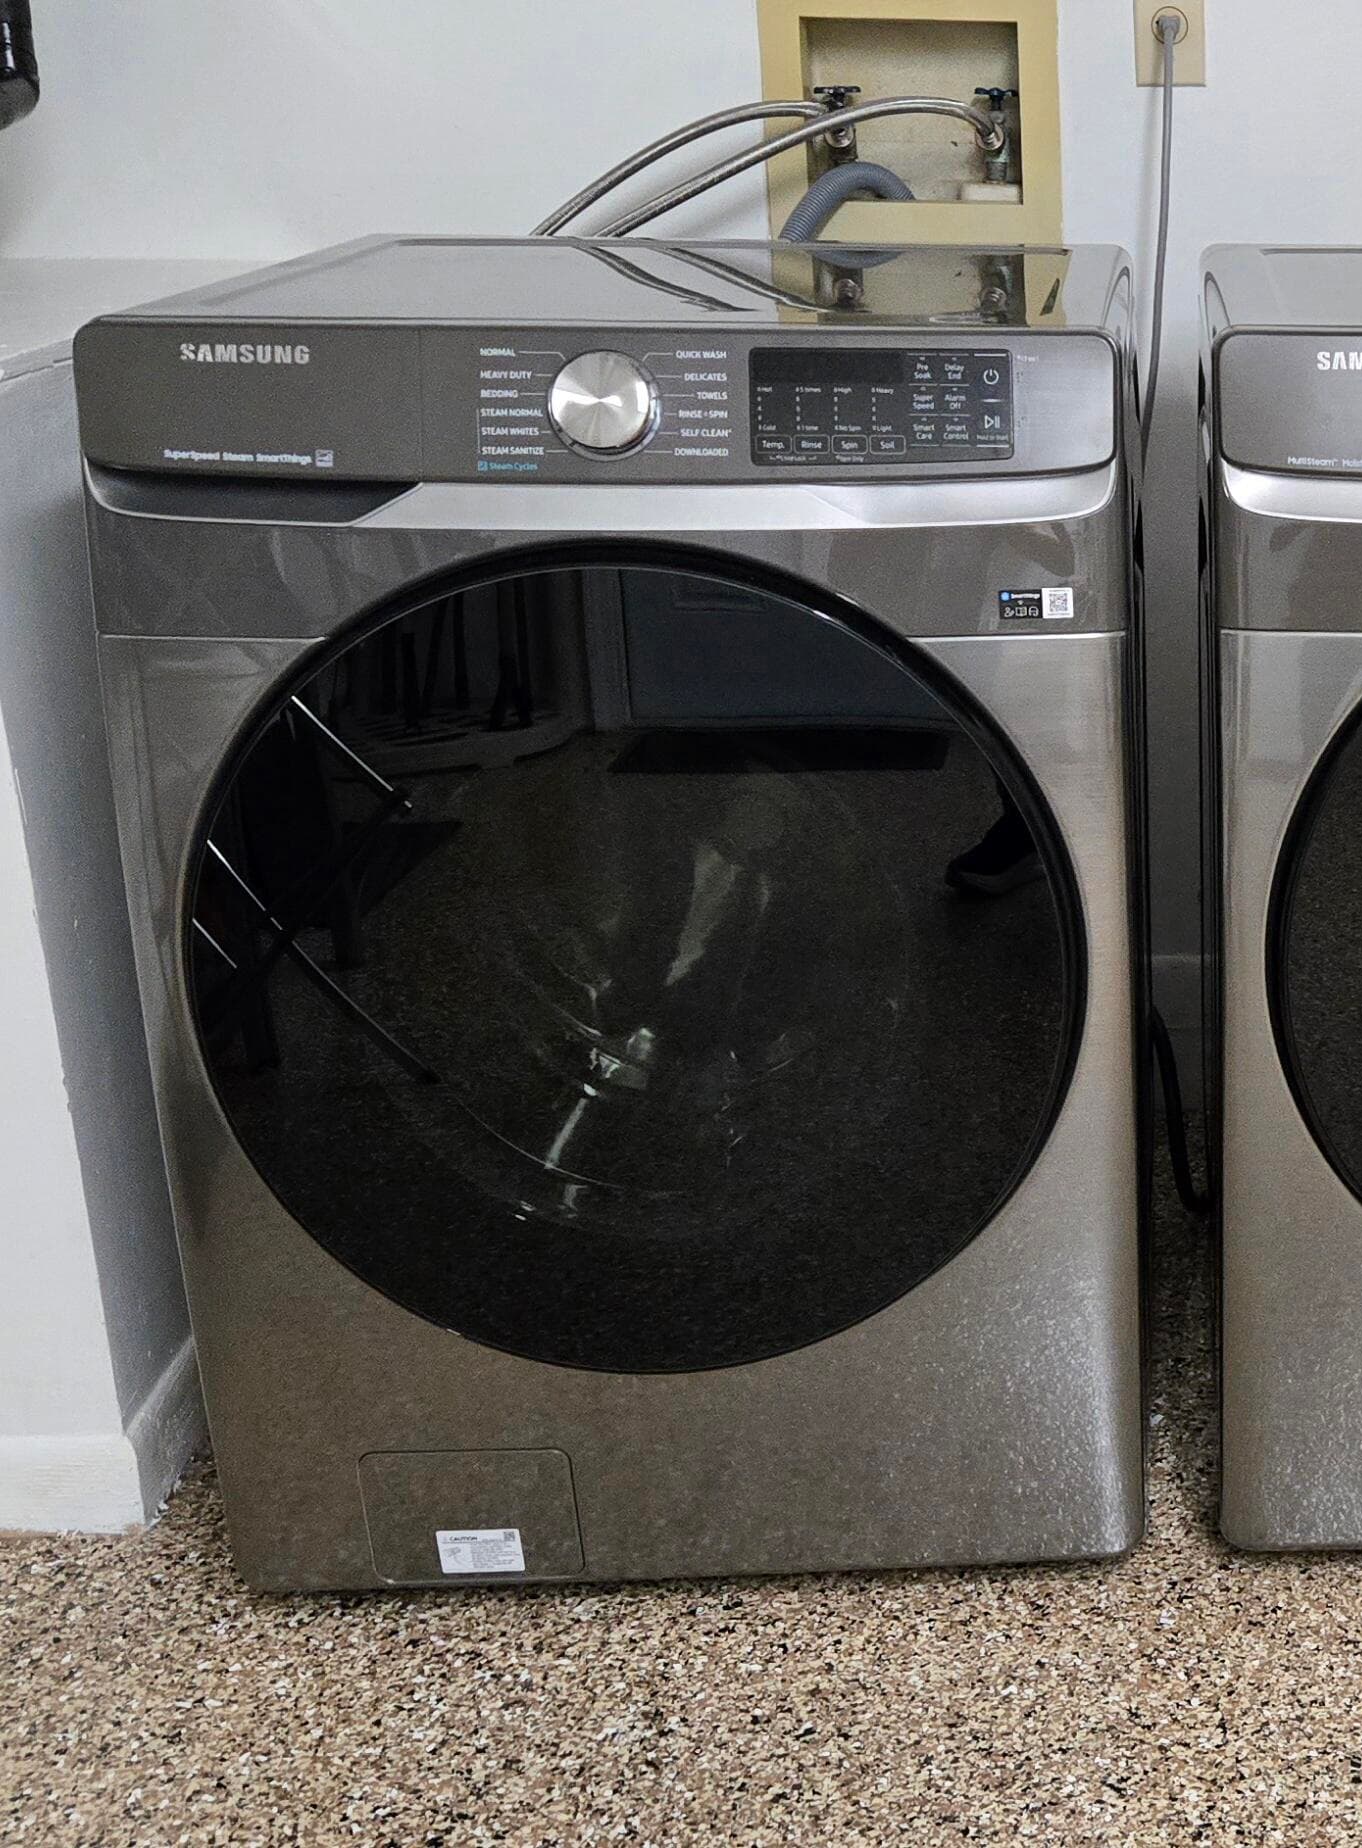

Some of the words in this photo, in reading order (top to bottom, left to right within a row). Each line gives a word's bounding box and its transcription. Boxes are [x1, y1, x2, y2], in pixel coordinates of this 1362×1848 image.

[179, 342, 310, 365] SAMSUNG
[479, 347, 516, 357] NORMAL
[675, 350, 701, 359] QUICK
[702, 350, 727, 359] WASH
[944, 363, 964, 372] Delay
[480, 370, 508, 379] HEAVY
[509, 371, 532, 380] DUTY
[684, 372, 728, 382] DELICATES
[914, 371, 932, 379] Soak
[480, 389, 519, 399] BEDDING
[696, 391, 728, 400] TOWELS
[912, 394, 933, 402] Super
[912, 402, 935, 410] Speed
[481, 407, 508, 418] STEAM
[509, 407, 544, 418] NORMAL
[678, 409, 702, 419] RINSE
[708, 409, 728, 419] SPIN
[481, 427, 508, 436] STEAM
[509, 426, 540, 436] WHITES
[680, 428, 700, 438] SELF
[945, 424, 966, 432] Smart
[916, 432, 933, 440] Care
[943, 432, 969, 440] Control
[801, 440, 822, 449] Rinse
[841, 440, 859, 450] Spin
[880, 440, 895, 449] Soil
[481, 446, 509, 456] STEAM
[510, 446, 545, 456] SANITIZE
[674, 447, 729, 457] DOWNLOADED
[489, 462, 514, 471] Steam
[514, 462, 538, 472] Cycles
